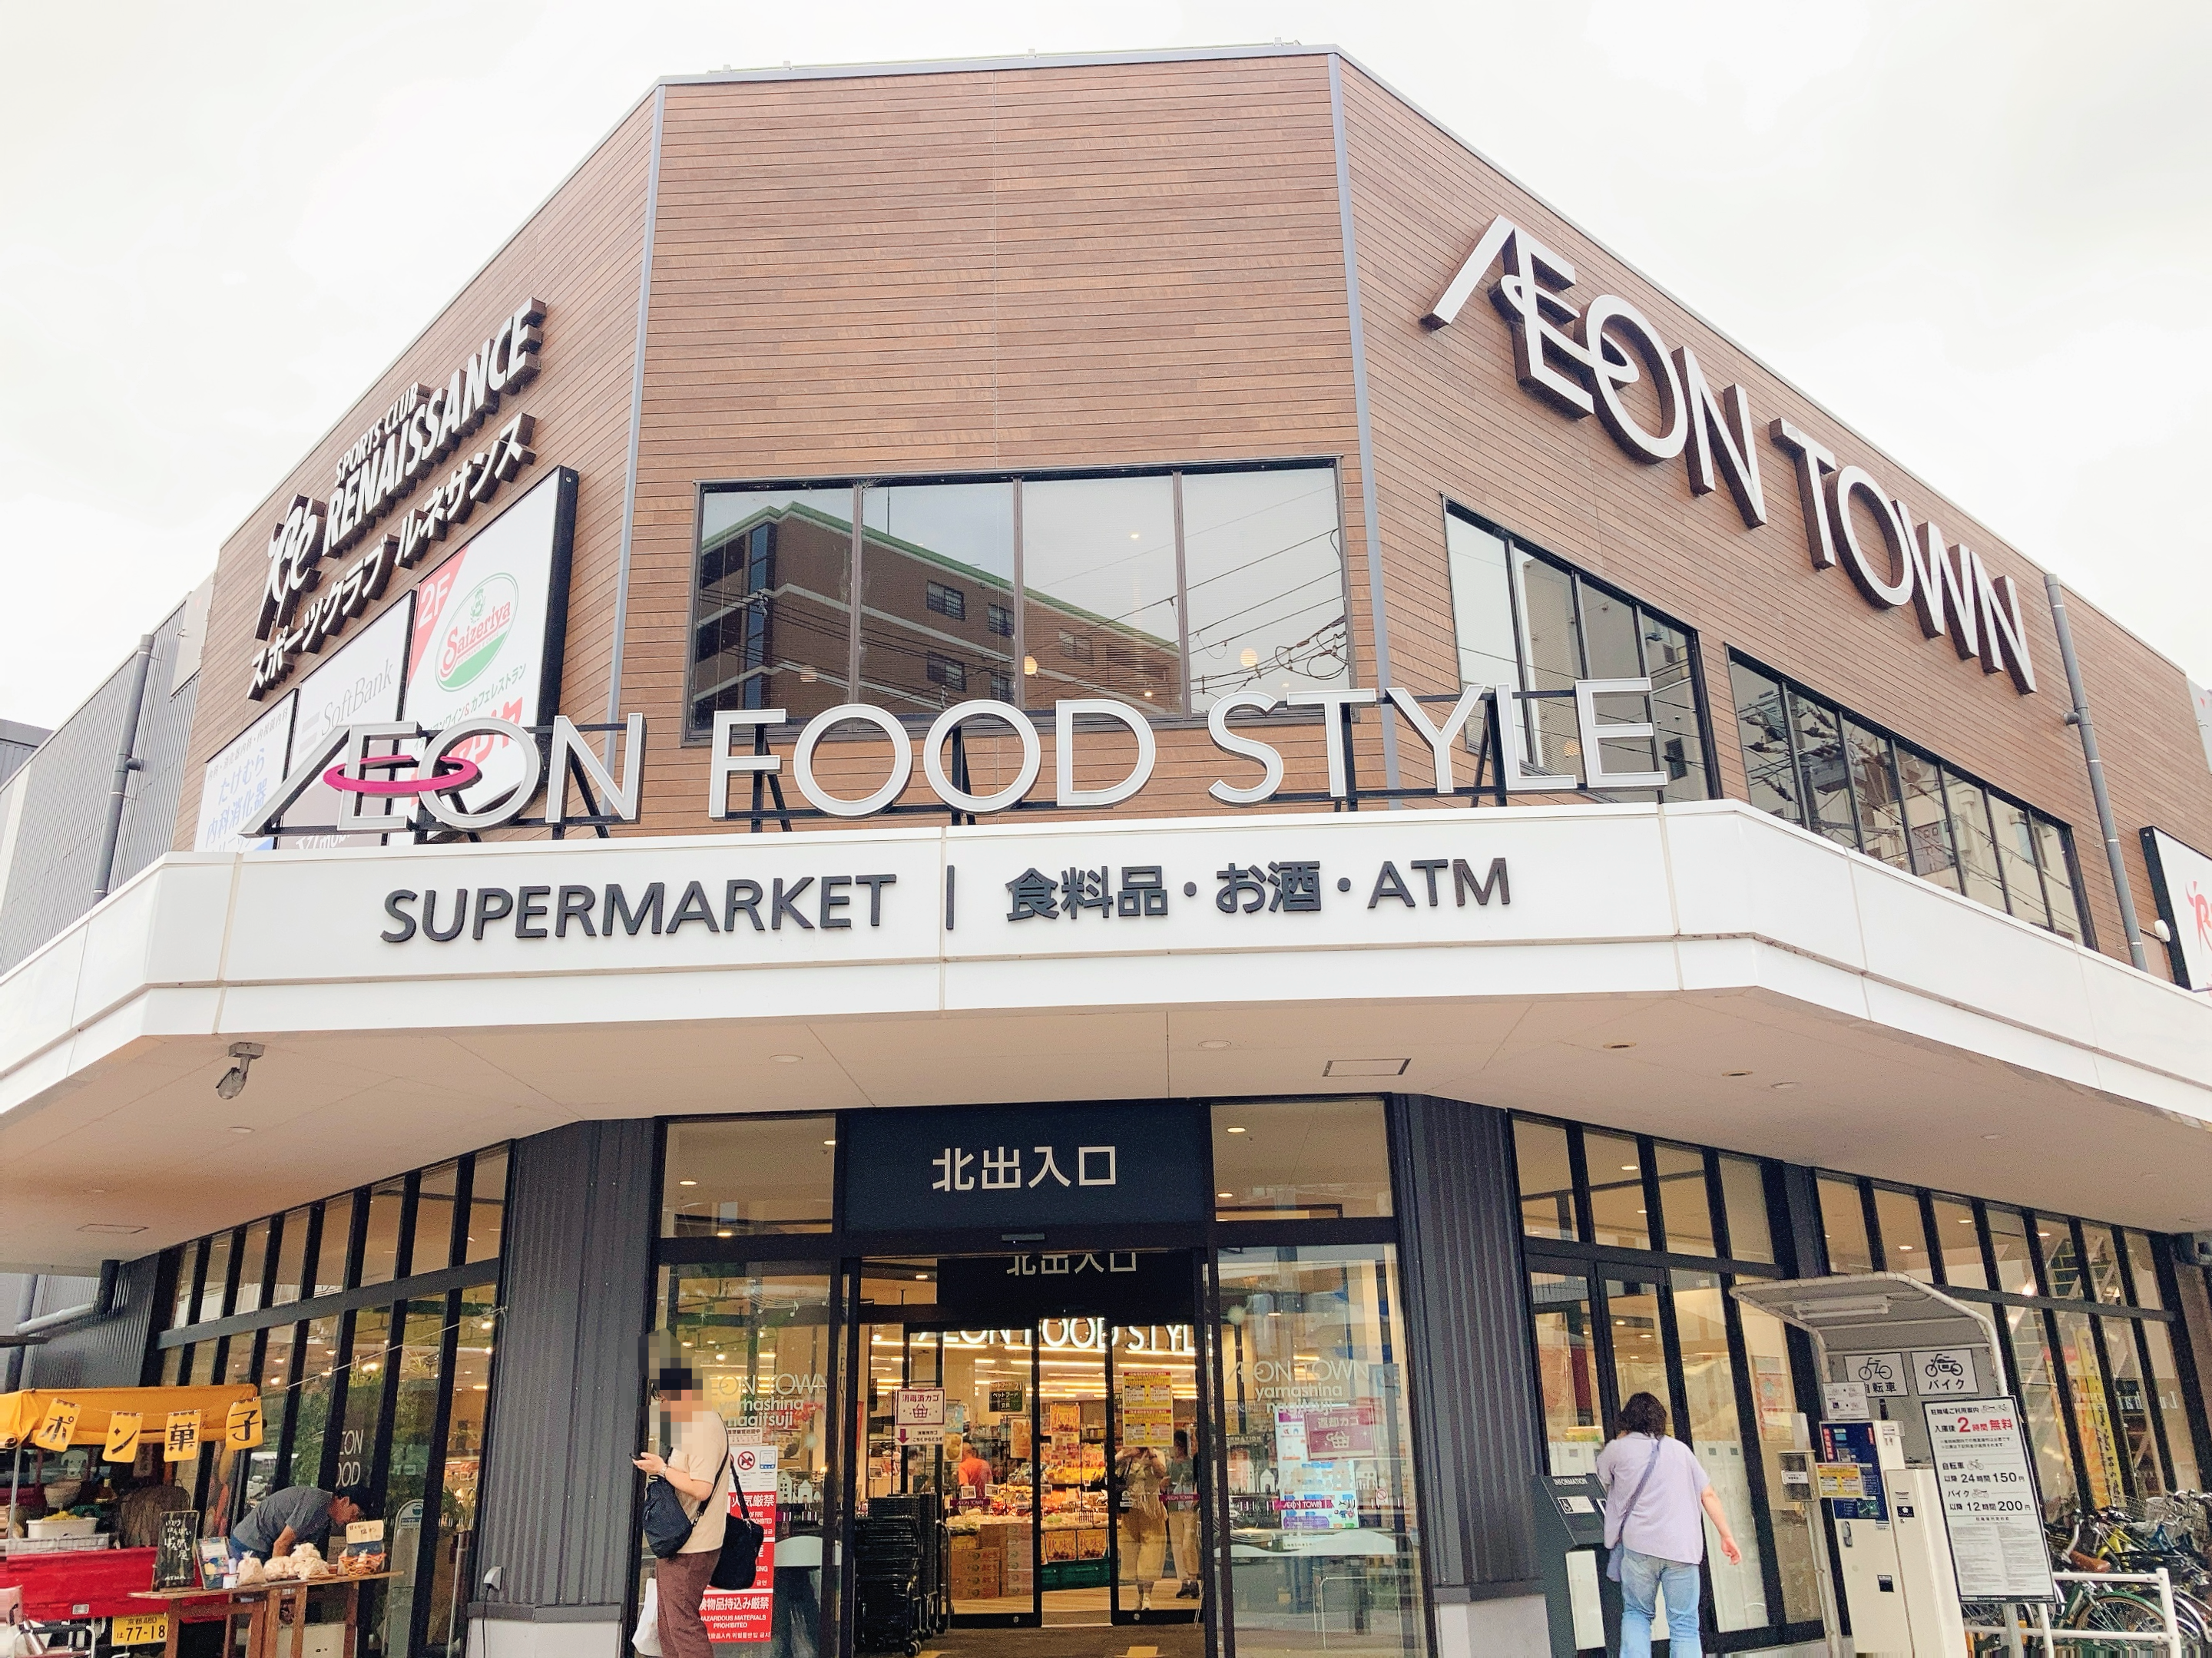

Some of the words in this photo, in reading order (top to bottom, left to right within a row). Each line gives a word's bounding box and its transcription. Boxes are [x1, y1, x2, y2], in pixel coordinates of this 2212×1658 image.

[322, 296, 540, 558] RENAISSANCE
[334, 417, 387, 488] SPORTS
[384, 381, 424, 435] CLUB
[1771, 417, 2038, 695] TOWN
[417, 572, 451, 630] 2F
[439, 601, 511, 678] Saizeriya
[321, 658, 393, 736] SoftBank
[707, 698, 1156, 819] FOOD
[1207, 677, 1668, 806] STYLE
[379, 873, 897, 945] SUPERMARKET
[932, 1146, 1117, 1192] 北出入口
[1254, 1383, 1343, 1402] yamashina
[1929, 1379, 1965, 1390] バイク
[727, 1411, 793, 1429] nagitsuji
[339, 1429, 364, 1454] ON
[336, 1461, 361, 1488] OD
[1942, 1461, 1965, 1471] 自転車
[1553, 1478, 1588, 1486] INFORMATION
[1948, 1489, 1969, 1497] バイク
[731, 1494, 775, 1507] 火気厳禁
[126, 1624, 165, 1641] 77-18
